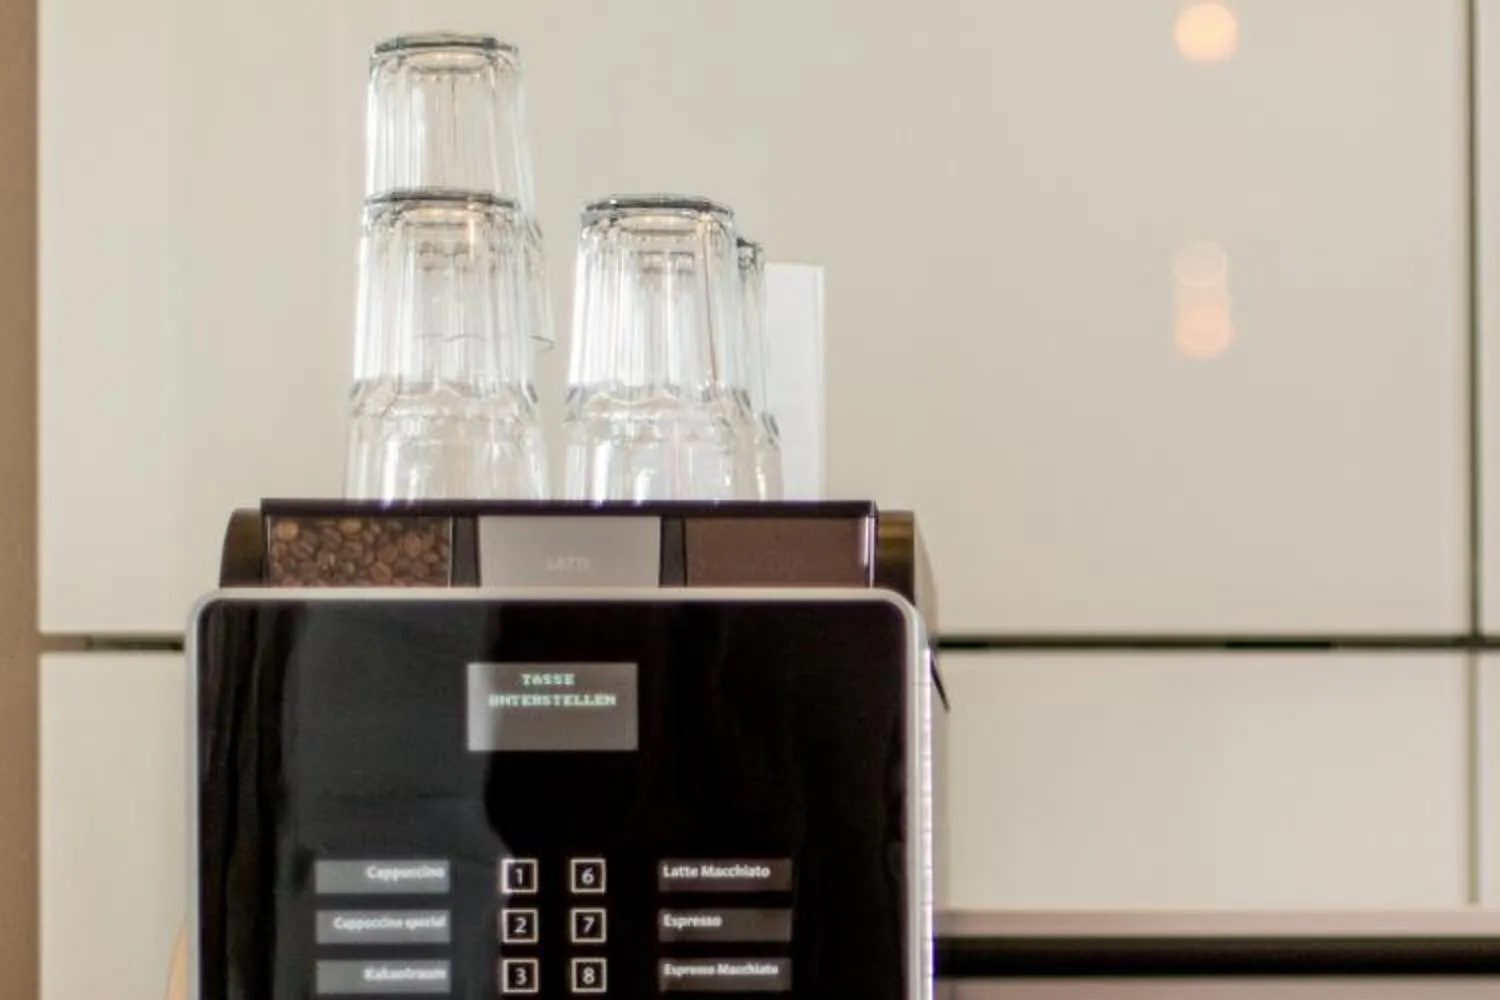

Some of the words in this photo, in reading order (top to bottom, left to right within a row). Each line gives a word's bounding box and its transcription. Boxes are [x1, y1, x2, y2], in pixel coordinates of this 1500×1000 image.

[521, 673, 575, 686] TASSE
[366, 866, 446, 881] Cappuccino
[515, 869, 524, 886] 1
[581, 867, 595, 885] 6
[663, 865, 698, 878] Latte
[701, 865, 771, 878] Macchiato
[515, 917, 526, 933] 2
[583, 917, 595, 933] 7
[663, 914, 723, 930] Espresso
[515, 968, 527, 985] 3
[582, 967, 595, 985] 8
[664, 963, 715, 978] Espresso
